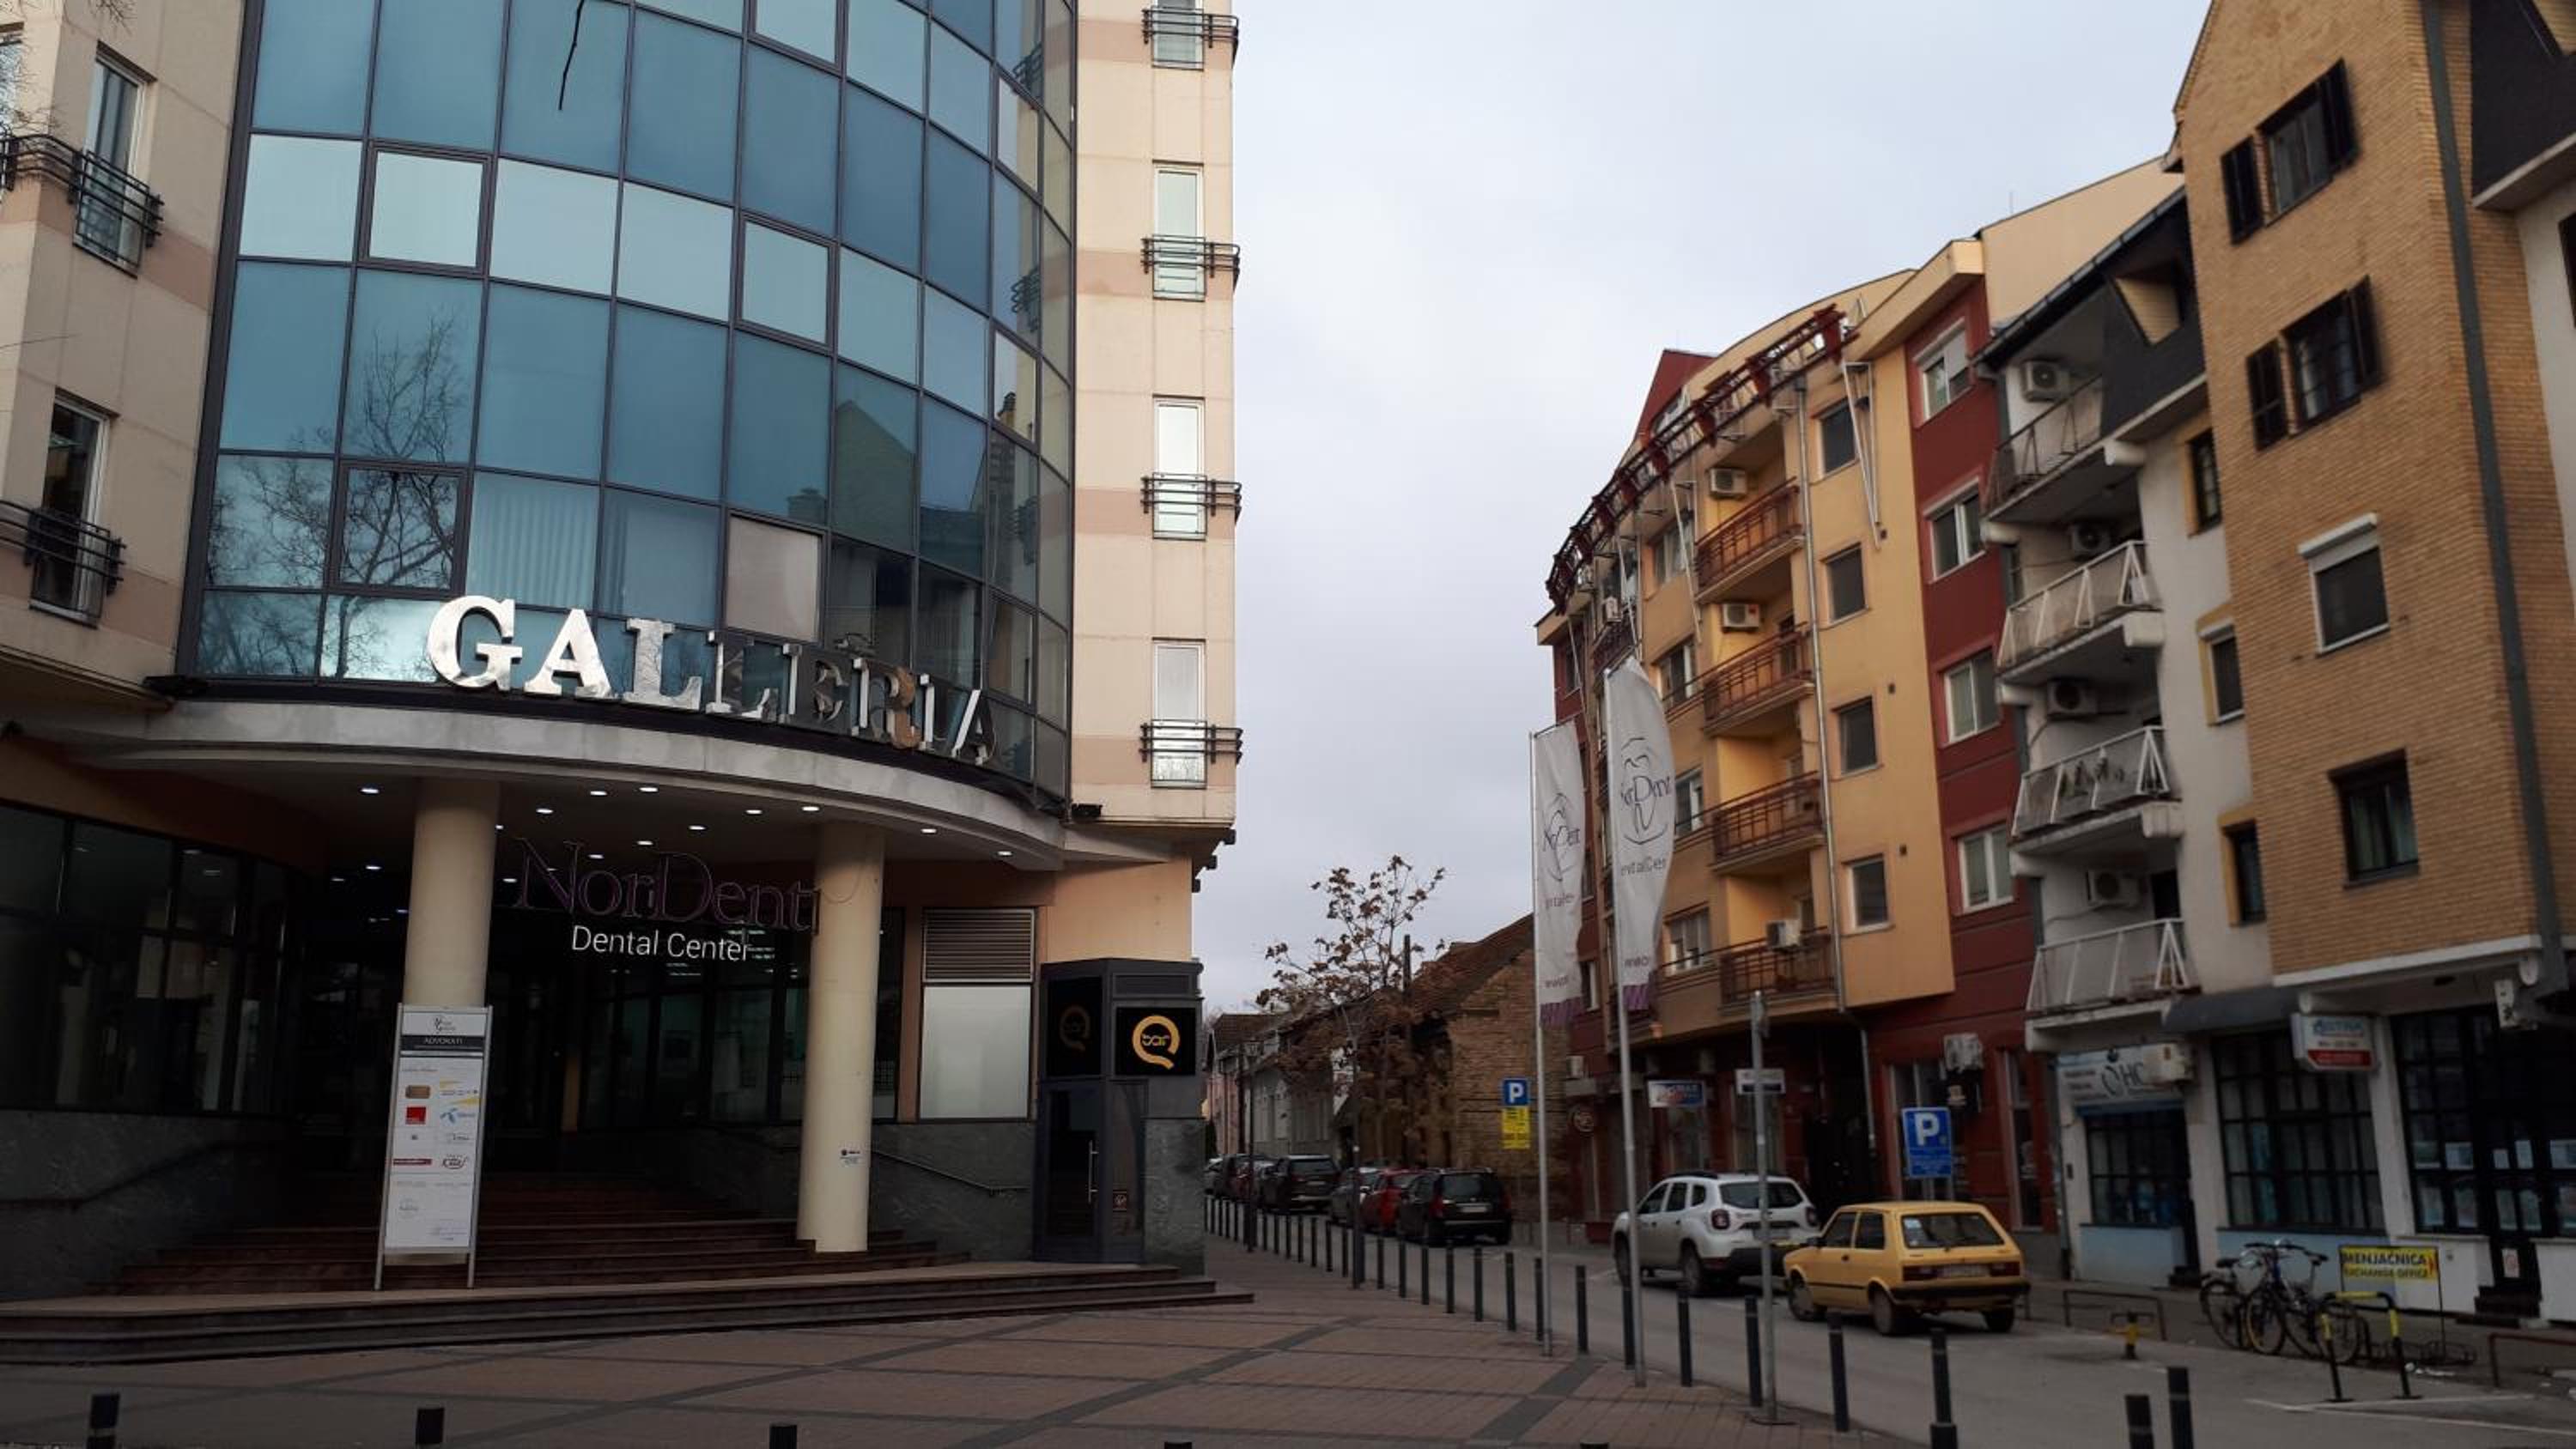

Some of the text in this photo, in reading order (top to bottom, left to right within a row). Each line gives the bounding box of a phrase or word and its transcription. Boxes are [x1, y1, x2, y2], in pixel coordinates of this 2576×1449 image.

[512, 839, 819, 933] NorDent
[572, 925, 750, 961] Dental Center
[1509, 1082, 1524, 1104] P
[1914, 1112, 1941, 1147] P
